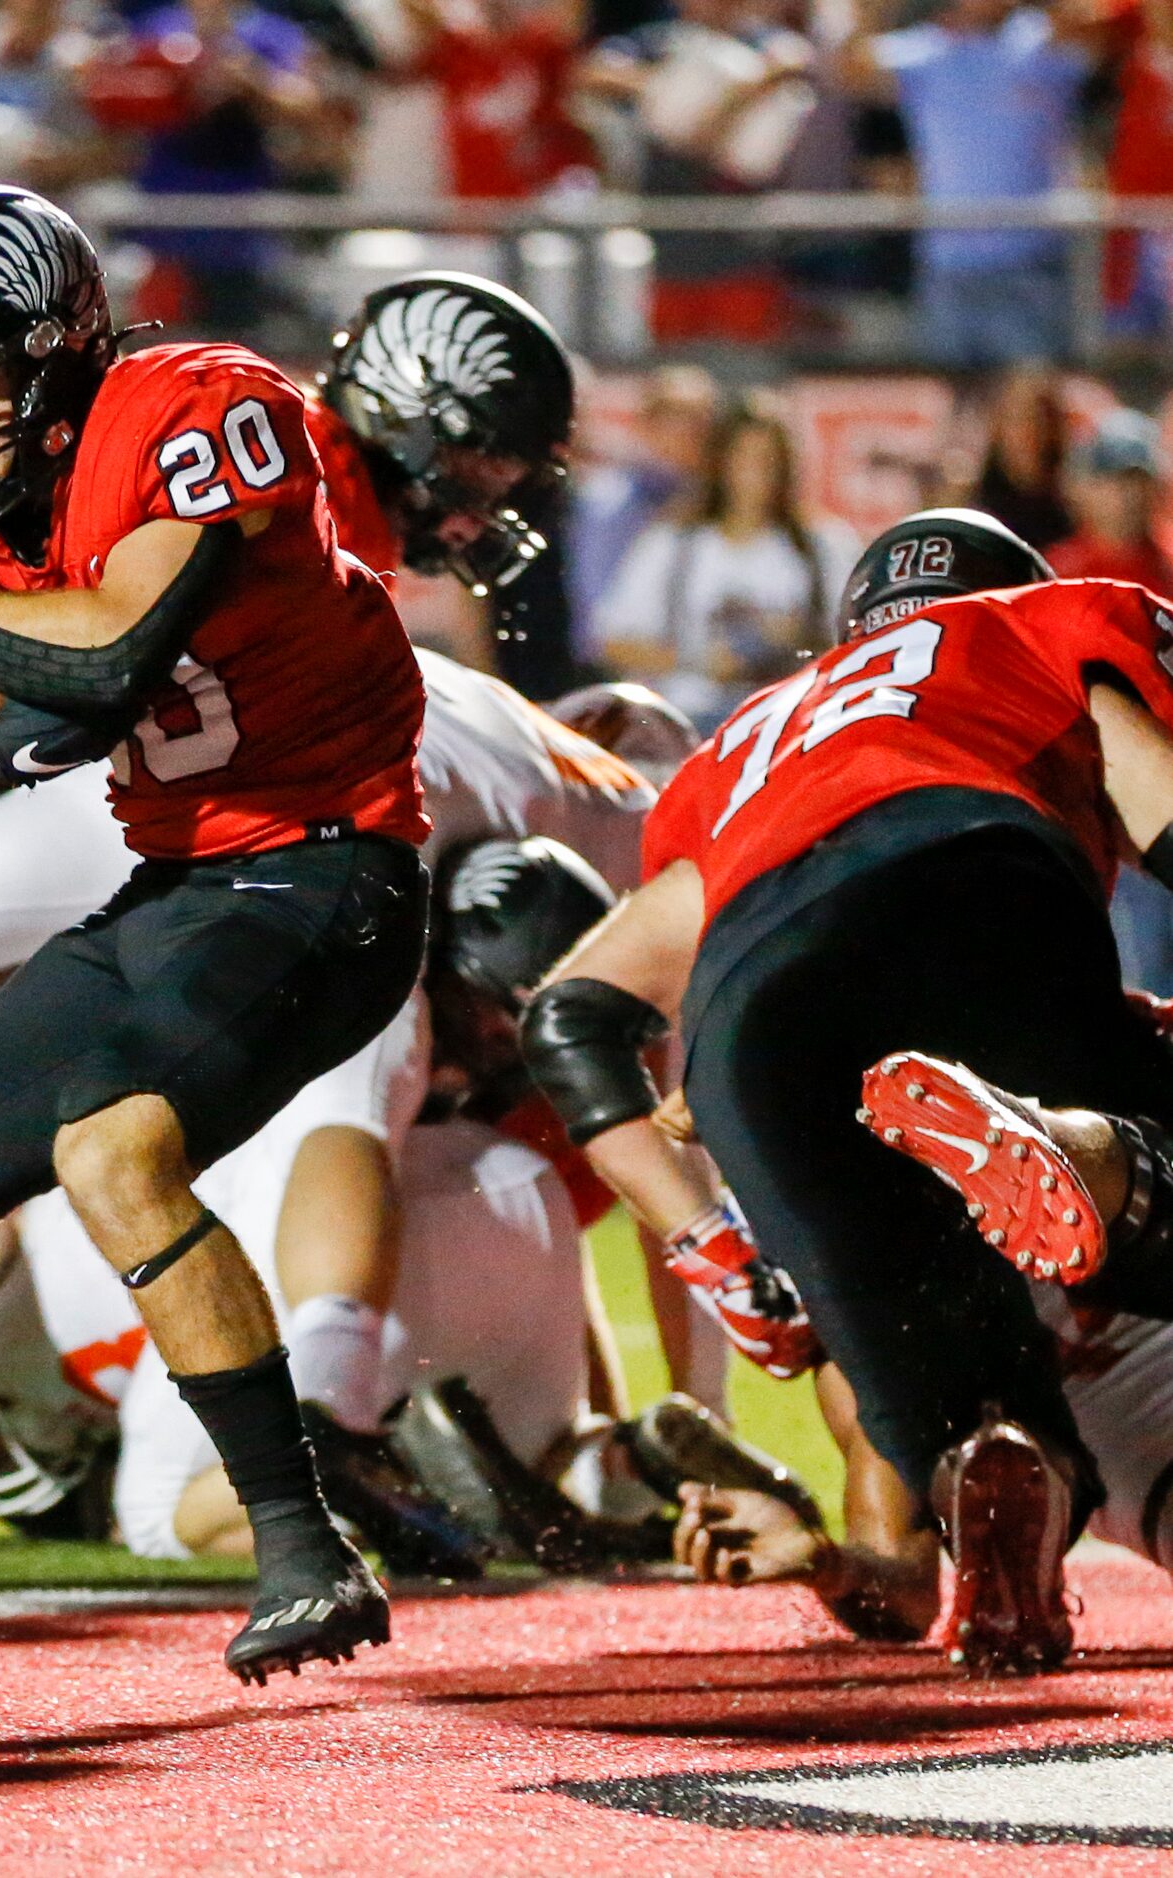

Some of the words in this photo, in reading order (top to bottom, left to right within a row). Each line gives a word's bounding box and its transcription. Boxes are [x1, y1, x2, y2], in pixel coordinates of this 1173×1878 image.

[157, 396, 287, 518] 20
[889, 536, 954, 583] 72
[710, 617, 944, 841] 72
[320, 825, 340, 839] M
